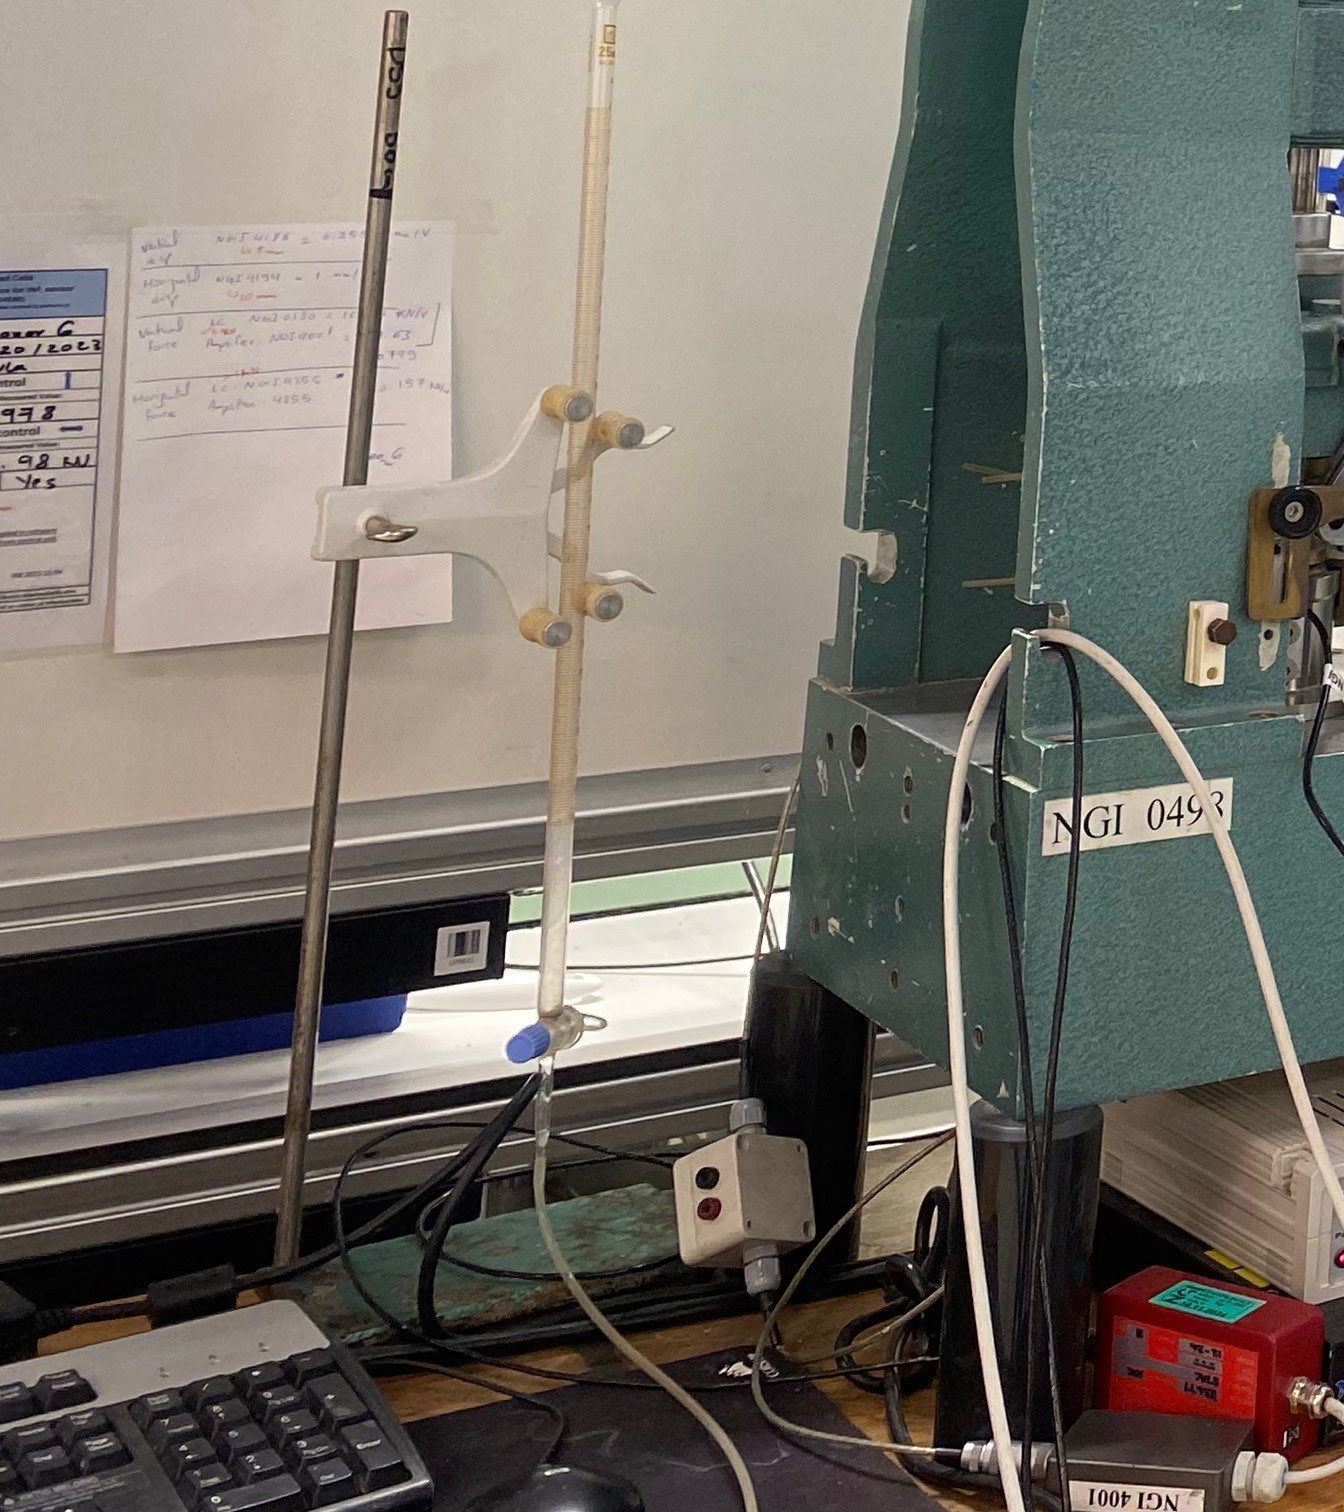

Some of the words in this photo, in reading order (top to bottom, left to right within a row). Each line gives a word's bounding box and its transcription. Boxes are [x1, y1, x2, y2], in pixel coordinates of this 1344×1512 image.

[16, 474, 57, 489] Yes
[1052, 803, 1124, 845] NGI
[1088, 1488, 1132, 1509] 4001
[1137, 1491, 1179, 1512] NGI
